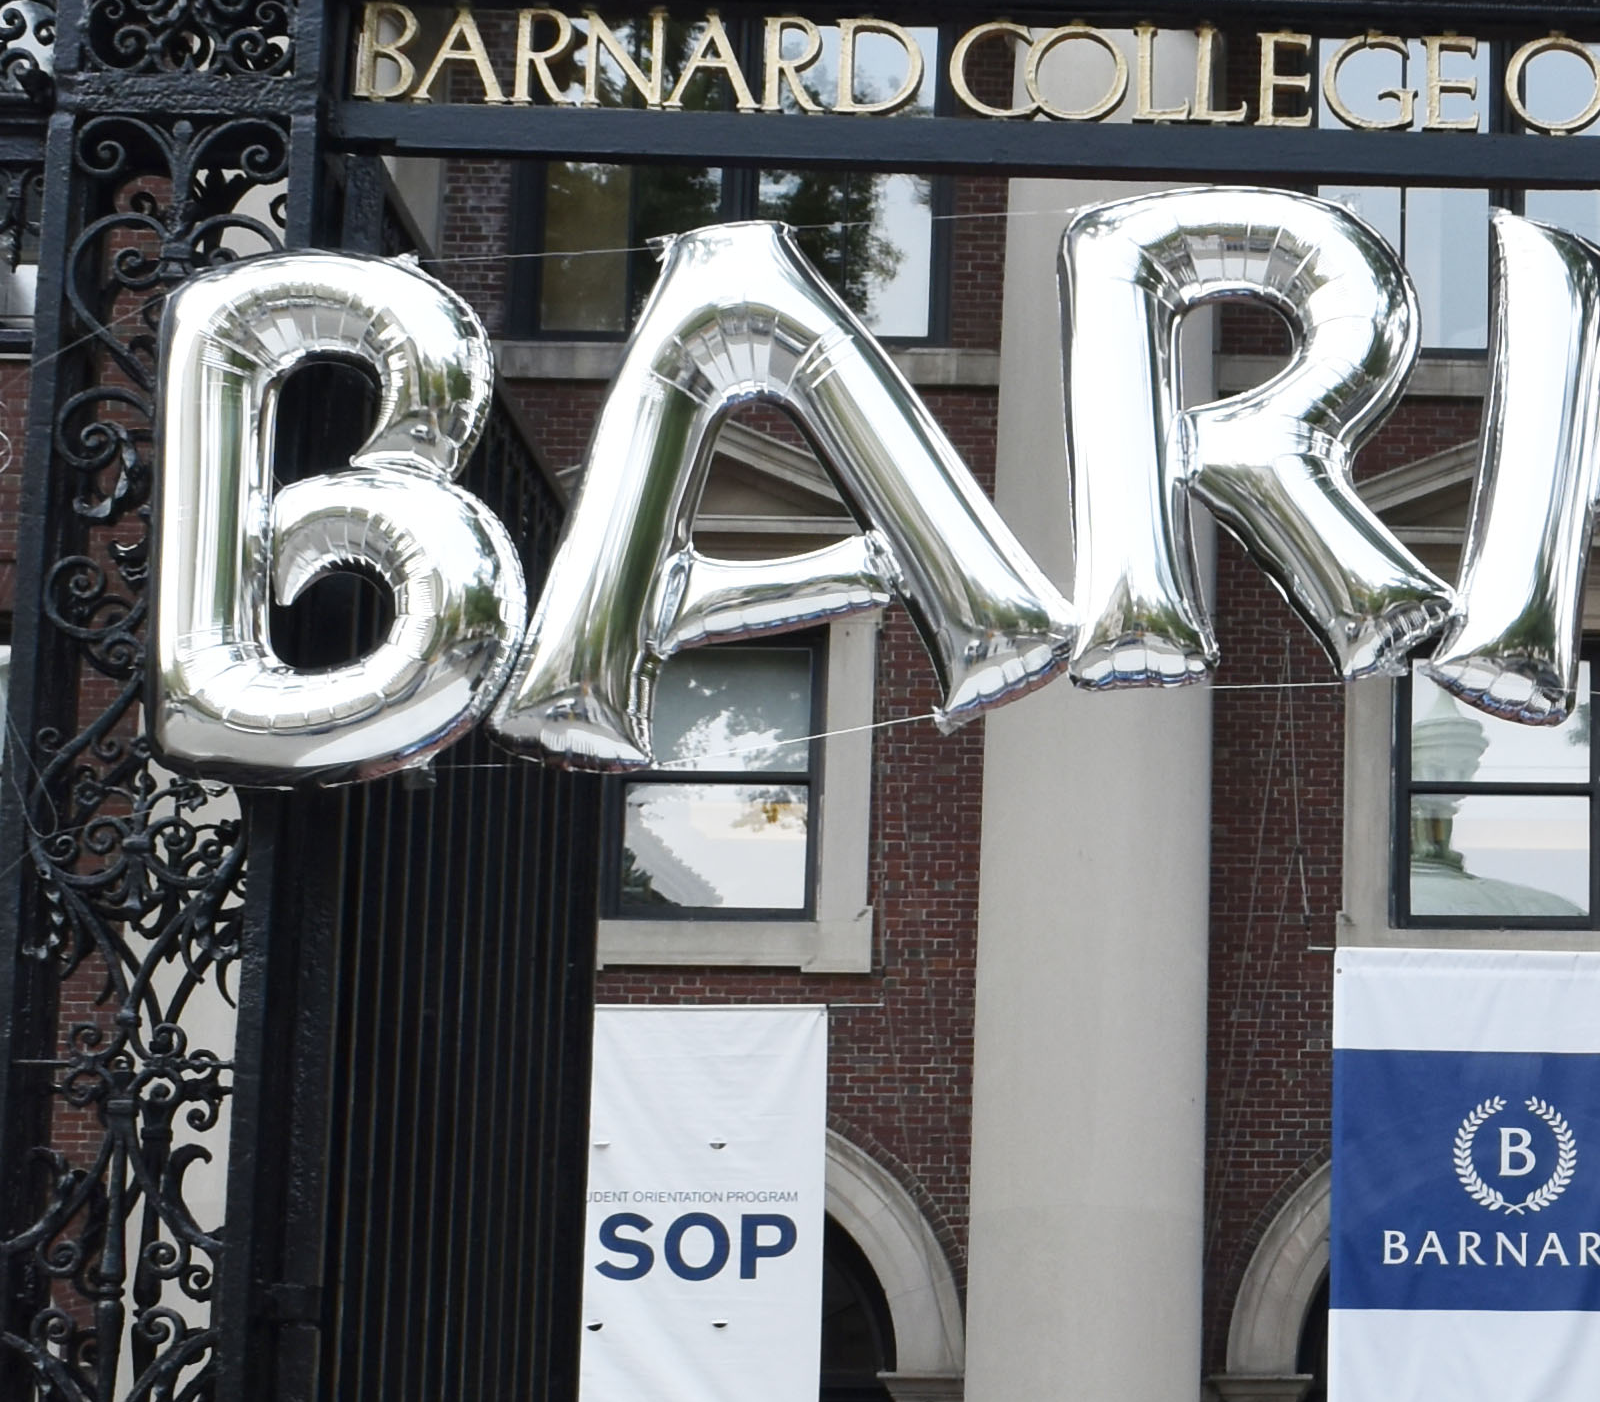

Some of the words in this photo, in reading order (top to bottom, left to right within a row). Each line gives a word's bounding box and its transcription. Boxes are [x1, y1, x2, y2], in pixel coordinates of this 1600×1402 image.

[352, 1, 924, 114] BARNARD
[949, 21, 1480, 133] COLLEGE
[1498, 1127, 1537, 1177] B
[632, 1191, 723, 1204] ORIENTATION
[726, 1191, 798, 1203] PROGRAM
[594, 1211, 798, 1282] SOP
